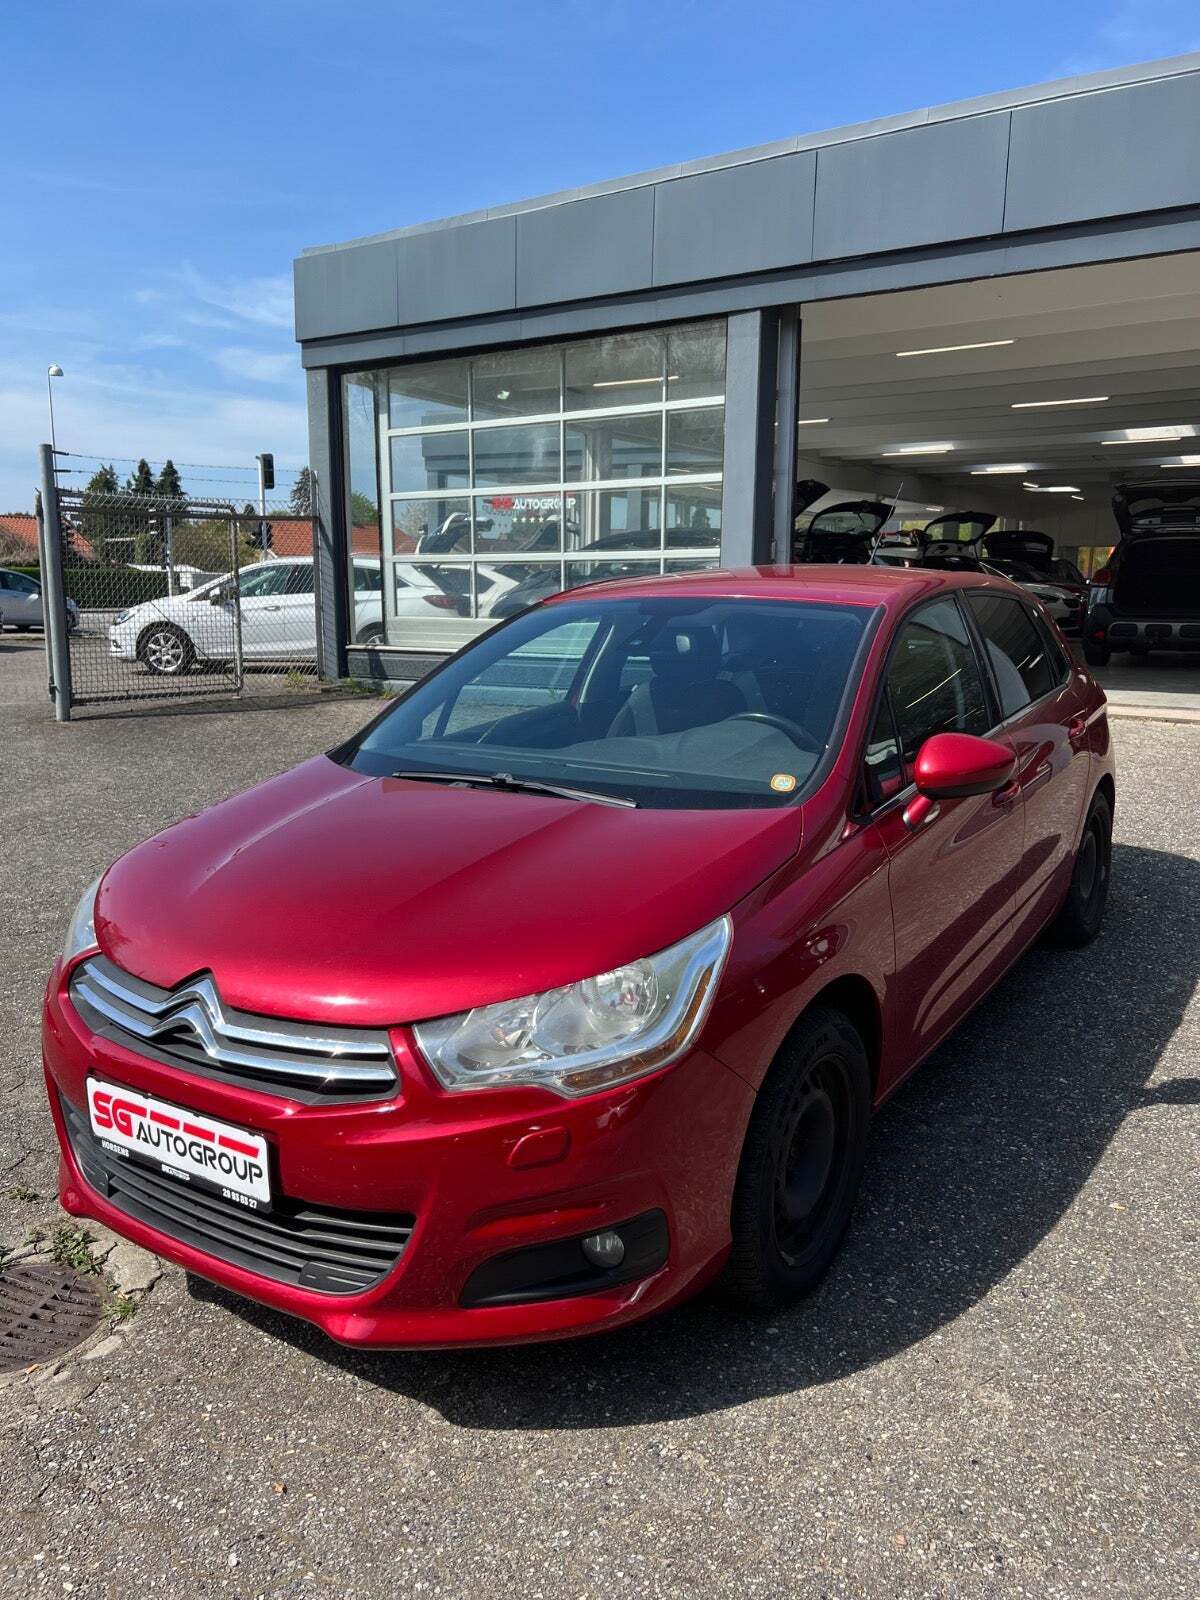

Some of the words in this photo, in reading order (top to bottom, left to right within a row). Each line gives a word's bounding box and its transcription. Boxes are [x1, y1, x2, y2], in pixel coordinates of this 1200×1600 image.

[512, 497, 576, 510] AUTOGROP
[93, 1090, 146, 1138] SG
[136, 1121, 263, 1184] AUTOGROUP
[249, 1198, 258, 1209] 27
